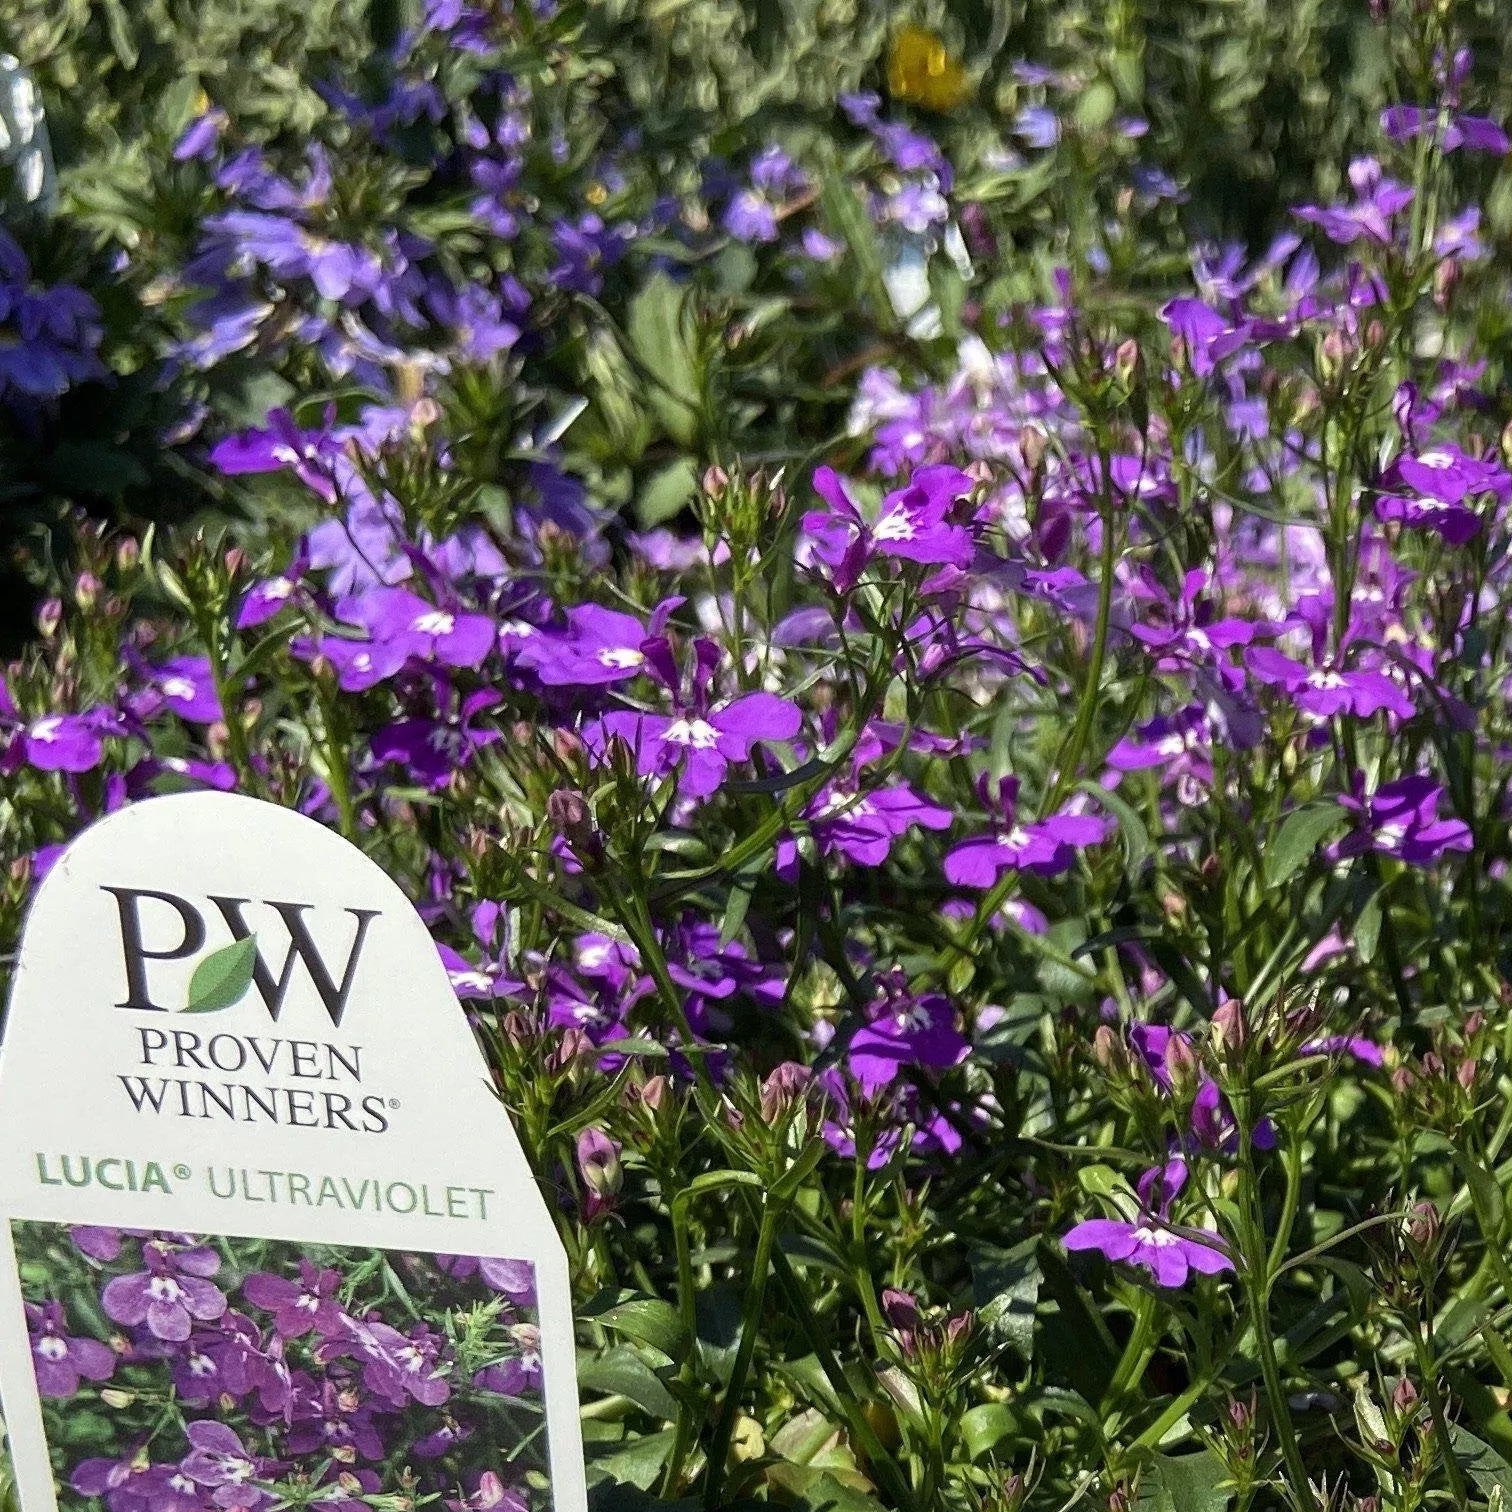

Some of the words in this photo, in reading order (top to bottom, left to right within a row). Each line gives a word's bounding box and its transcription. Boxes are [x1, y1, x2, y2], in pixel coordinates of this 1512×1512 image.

[100, 885, 383, 1029] PW
[136, 1026, 363, 1084] PROVEN
[207, 1167, 496, 1221] ULTRAVIOLET
